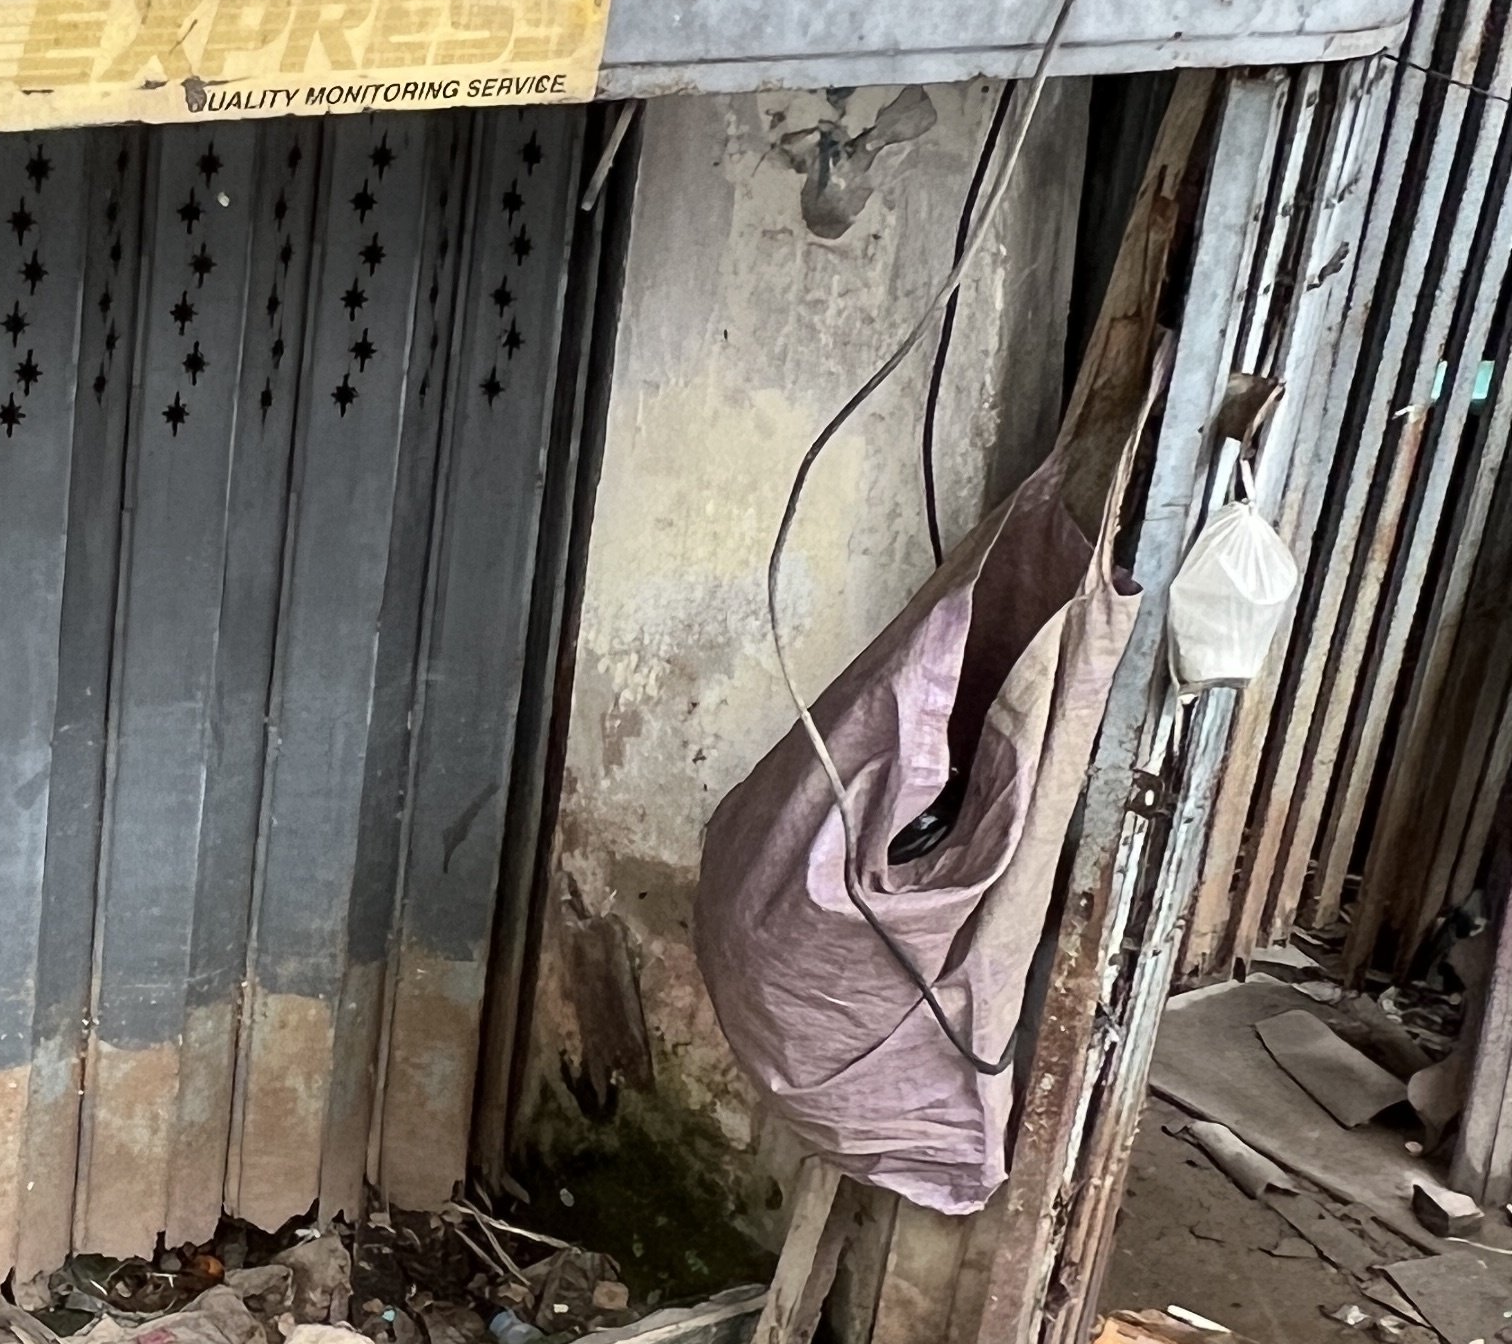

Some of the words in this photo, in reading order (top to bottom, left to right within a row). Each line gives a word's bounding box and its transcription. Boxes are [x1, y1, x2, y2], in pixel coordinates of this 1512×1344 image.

[186, 86, 299, 112] UALITY
[305, 80, 460, 106] MONITORING
[467, 74, 567, 97] SERVICE
